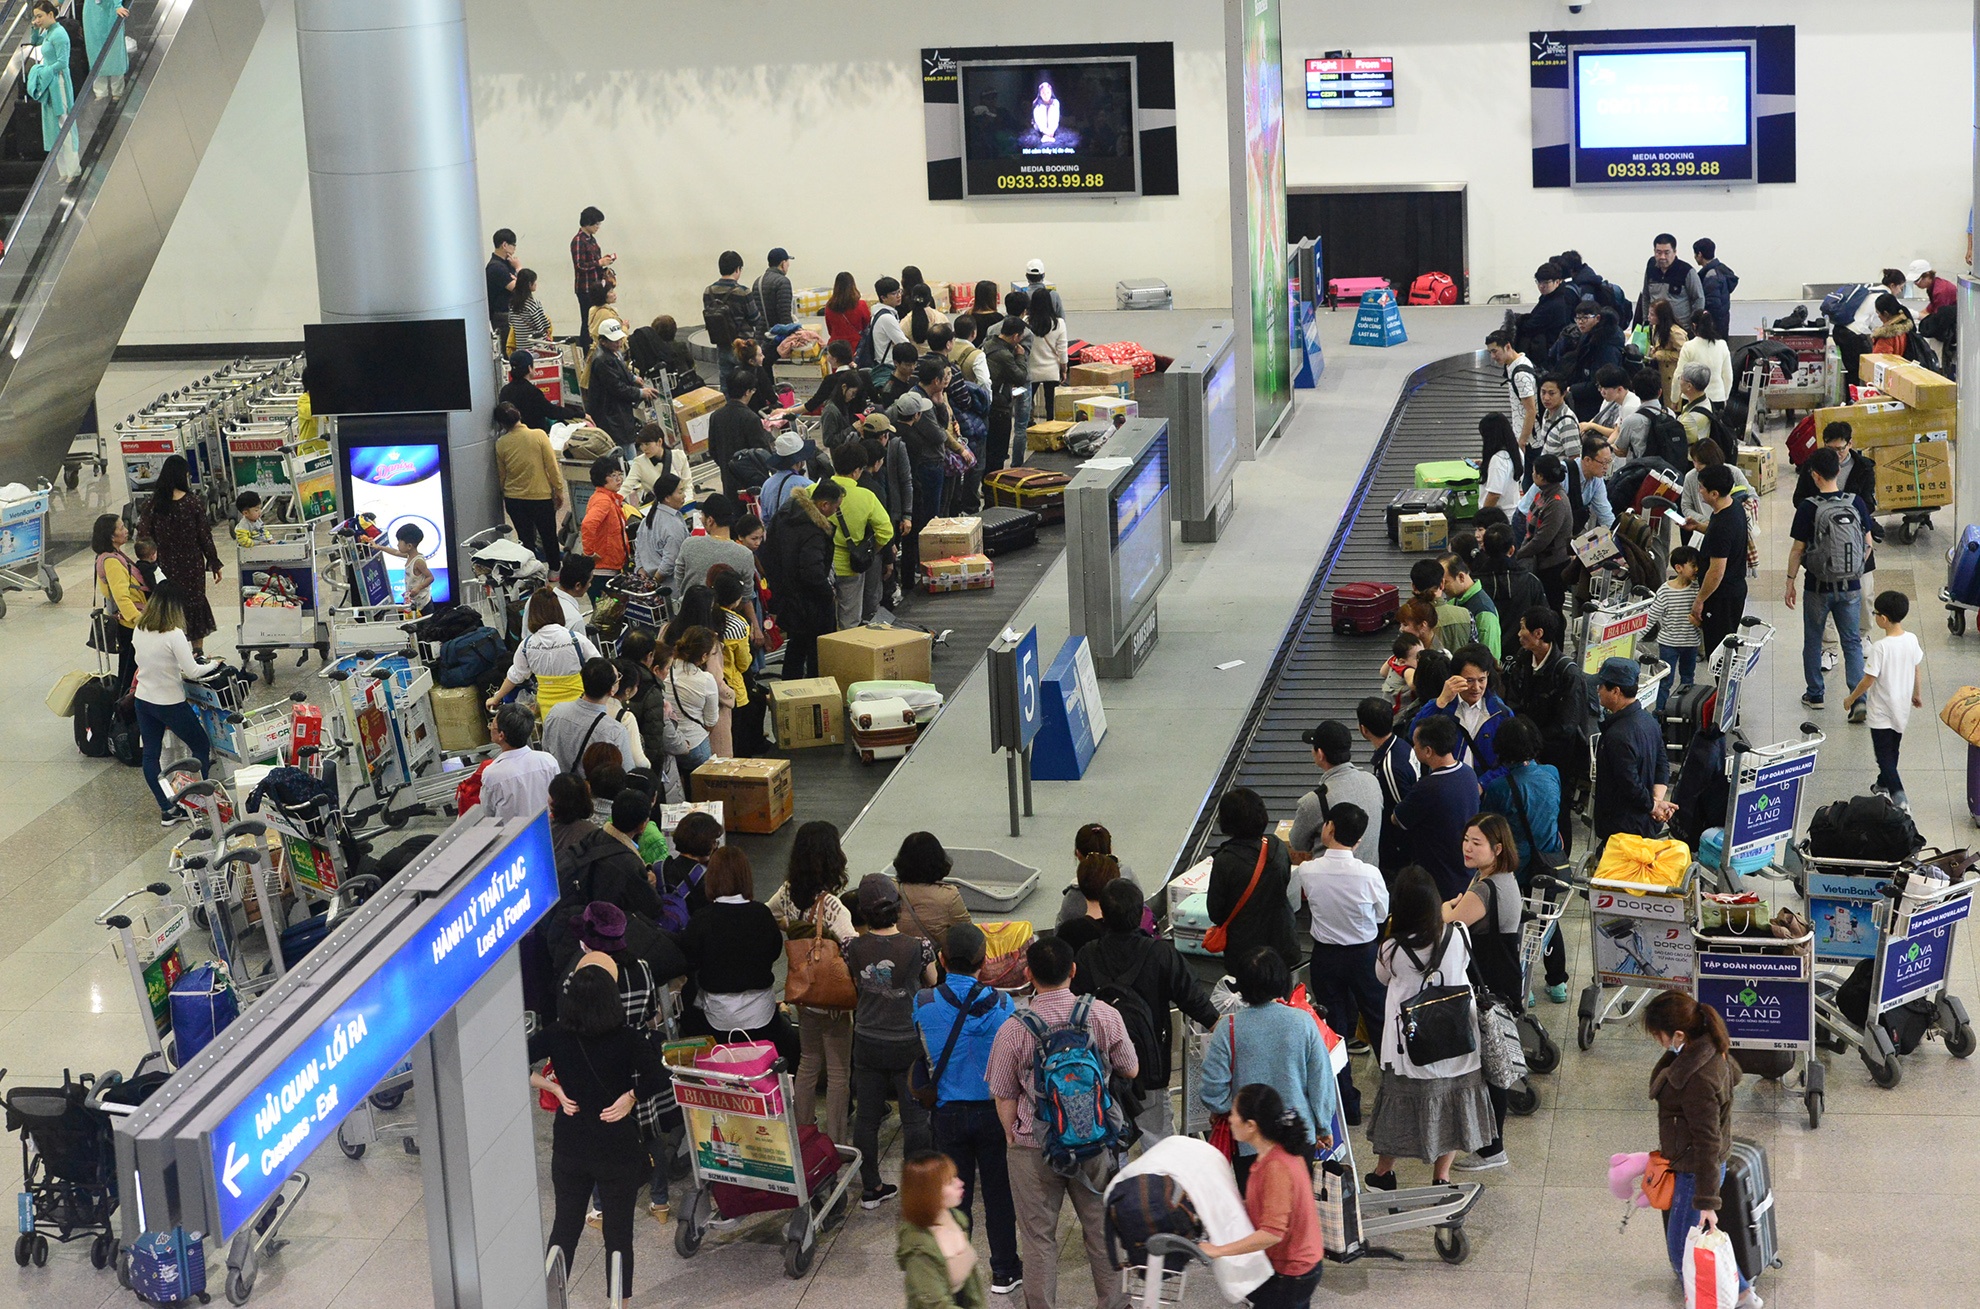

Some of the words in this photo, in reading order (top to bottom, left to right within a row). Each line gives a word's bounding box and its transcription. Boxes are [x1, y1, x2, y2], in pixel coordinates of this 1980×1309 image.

[1310, 61, 1337, 71] Flight
[1355, 59, 1380, 69] From
[1659, 152, 1694, 160] BOOKING
[1607, 161, 1720, 177] 0933.33.99.88
[997, 174, 1104, 188] 0933.33.99.88
[1316, 251, 1321, 295] 5
[235, 442, 248, 450] BIA
[373, 459, 416, 481] Danisa
[1133, 609, 1155, 655] SAMSUNG
[1607, 625, 1620, 638] BIA
[1023, 650, 1034, 722] 5
[266, 732, 278, 742] FE
[1758, 774, 1769, 782] TẬP
[1784, 761, 1813, 774] NOVALAND
[1747, 808, 1780, 825] LAND
[1822, 884, 1876, 897] VietinBank
[432, 916, 464, 964] HÀNH
[463, 897, 477, 933] LÝ
[478, 871, 505, 917] THẤT
[504, 856, 526, 892] LẠC
[1617, 899, 1675, 914] DORCO
[476, 924, 497, 958] Lost
[496, 916, 505, 938] &
[504, 888, 531, 931] Found
[1911, 921, 1923, 930] TẬP
[1938, 905, 1968, 922] NOVALAND
[157, 934, 166, 944] FE
[165, 917, 184, 938] CREDIT
[1653, 940, 1692, 950] DORCO
[1704, 961, 1721, 969] TẬP
[1722, 961, 1748, 969] ĐOÀN
[1749, 963, 1797, 971] NOVALAND
[1817, 957, 1848, 965] BIZMAN.VN
[1897, 957, 1931, 978] LAND
[1726, 1008, 1781, 1019] LAND
[255, 1092, 282, 1140] HẢI
[281, 1058, 320, 1113] QUAN
[325, 1023, 349, 1071] LỐI
[347, 1013, 368, 1049] RA
[683, 1088, 707, 1104] BIA
[260, 1116, 311, 1176] Customs
[315, 1083, 339, 1122] Exit
[708, 1172, 738, 1183] BIZMAN.VN
